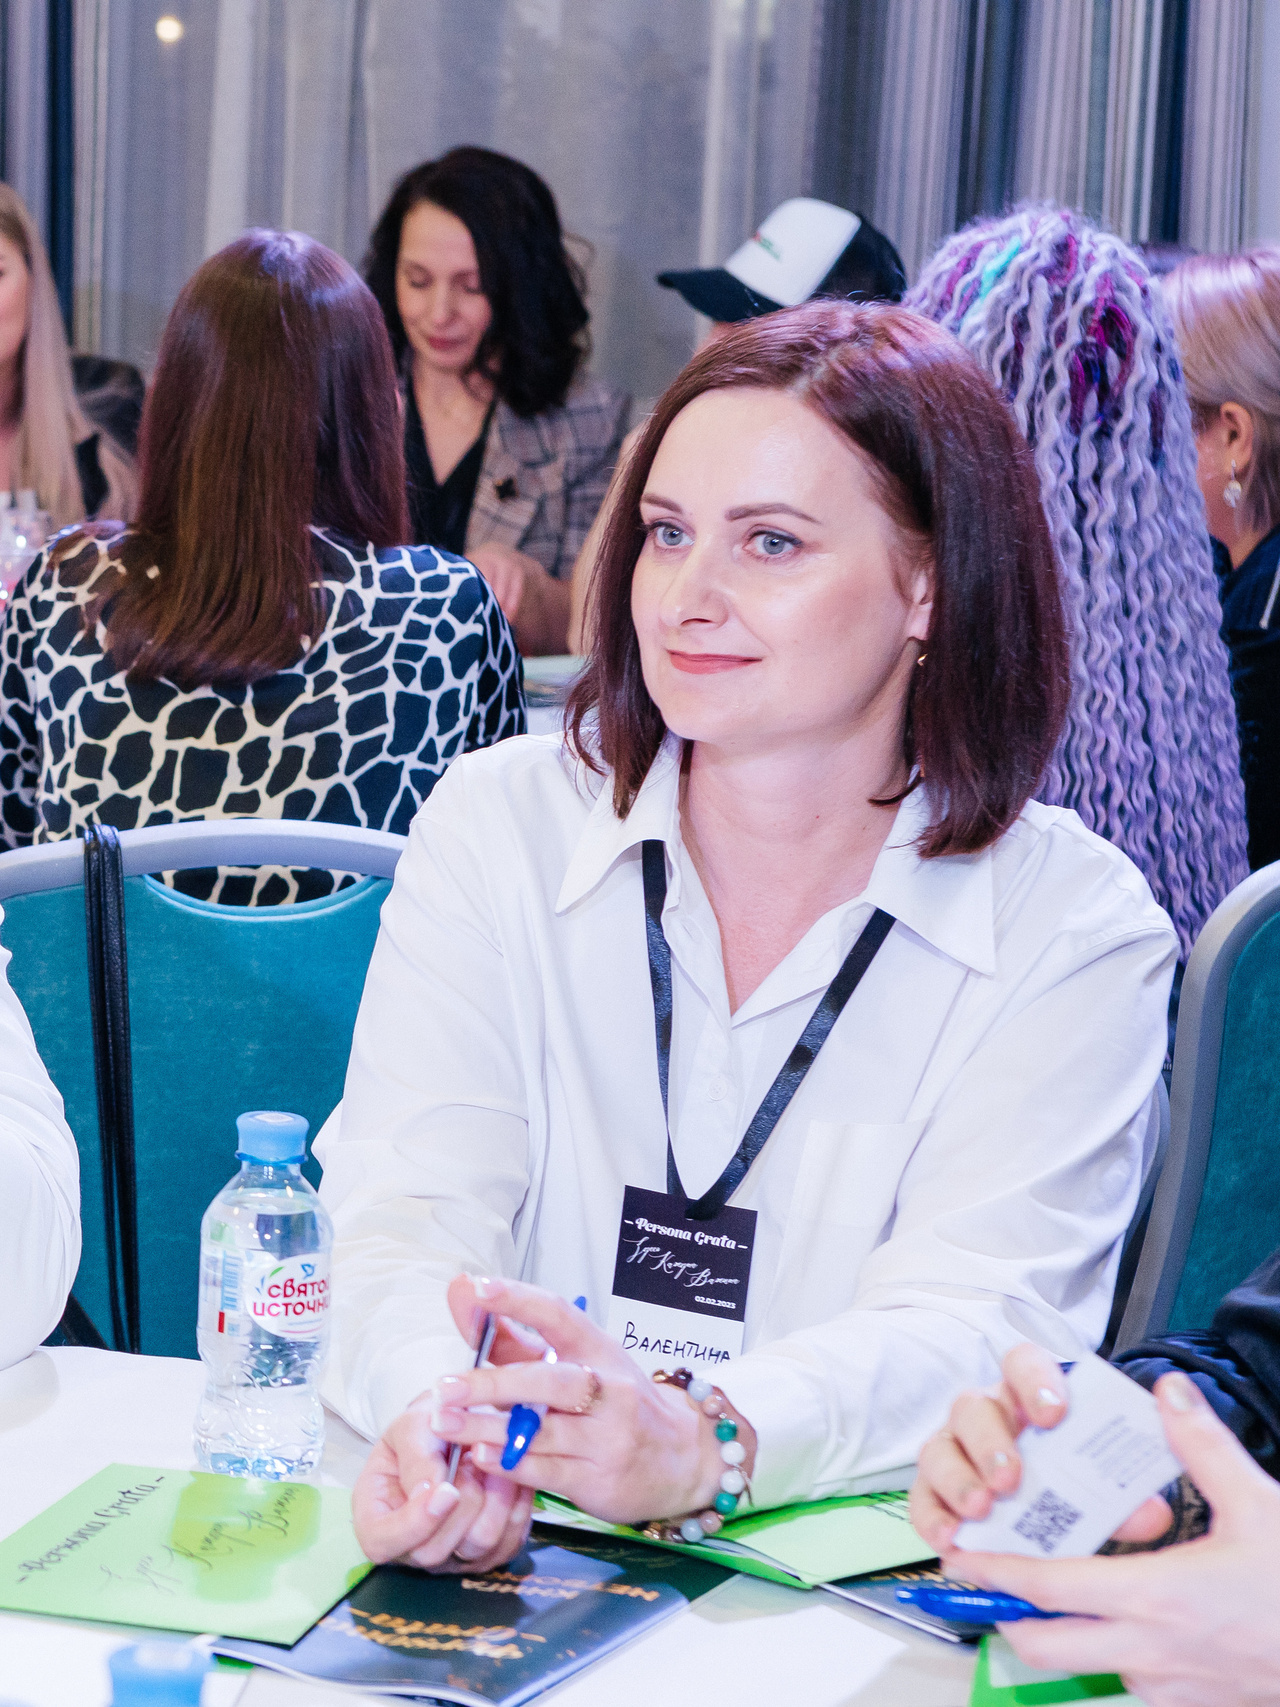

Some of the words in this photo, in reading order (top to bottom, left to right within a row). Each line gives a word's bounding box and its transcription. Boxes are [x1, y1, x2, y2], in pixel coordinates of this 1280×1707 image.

[635, 1217, 691, 1241] Persona
[694, 1232, 736, 1249] Grata
[694, 1296, 736, 1309] 02.02.2023
[19, 1521, 110, 1571] Persona
[94, 1484, 160, 1517] Grata
